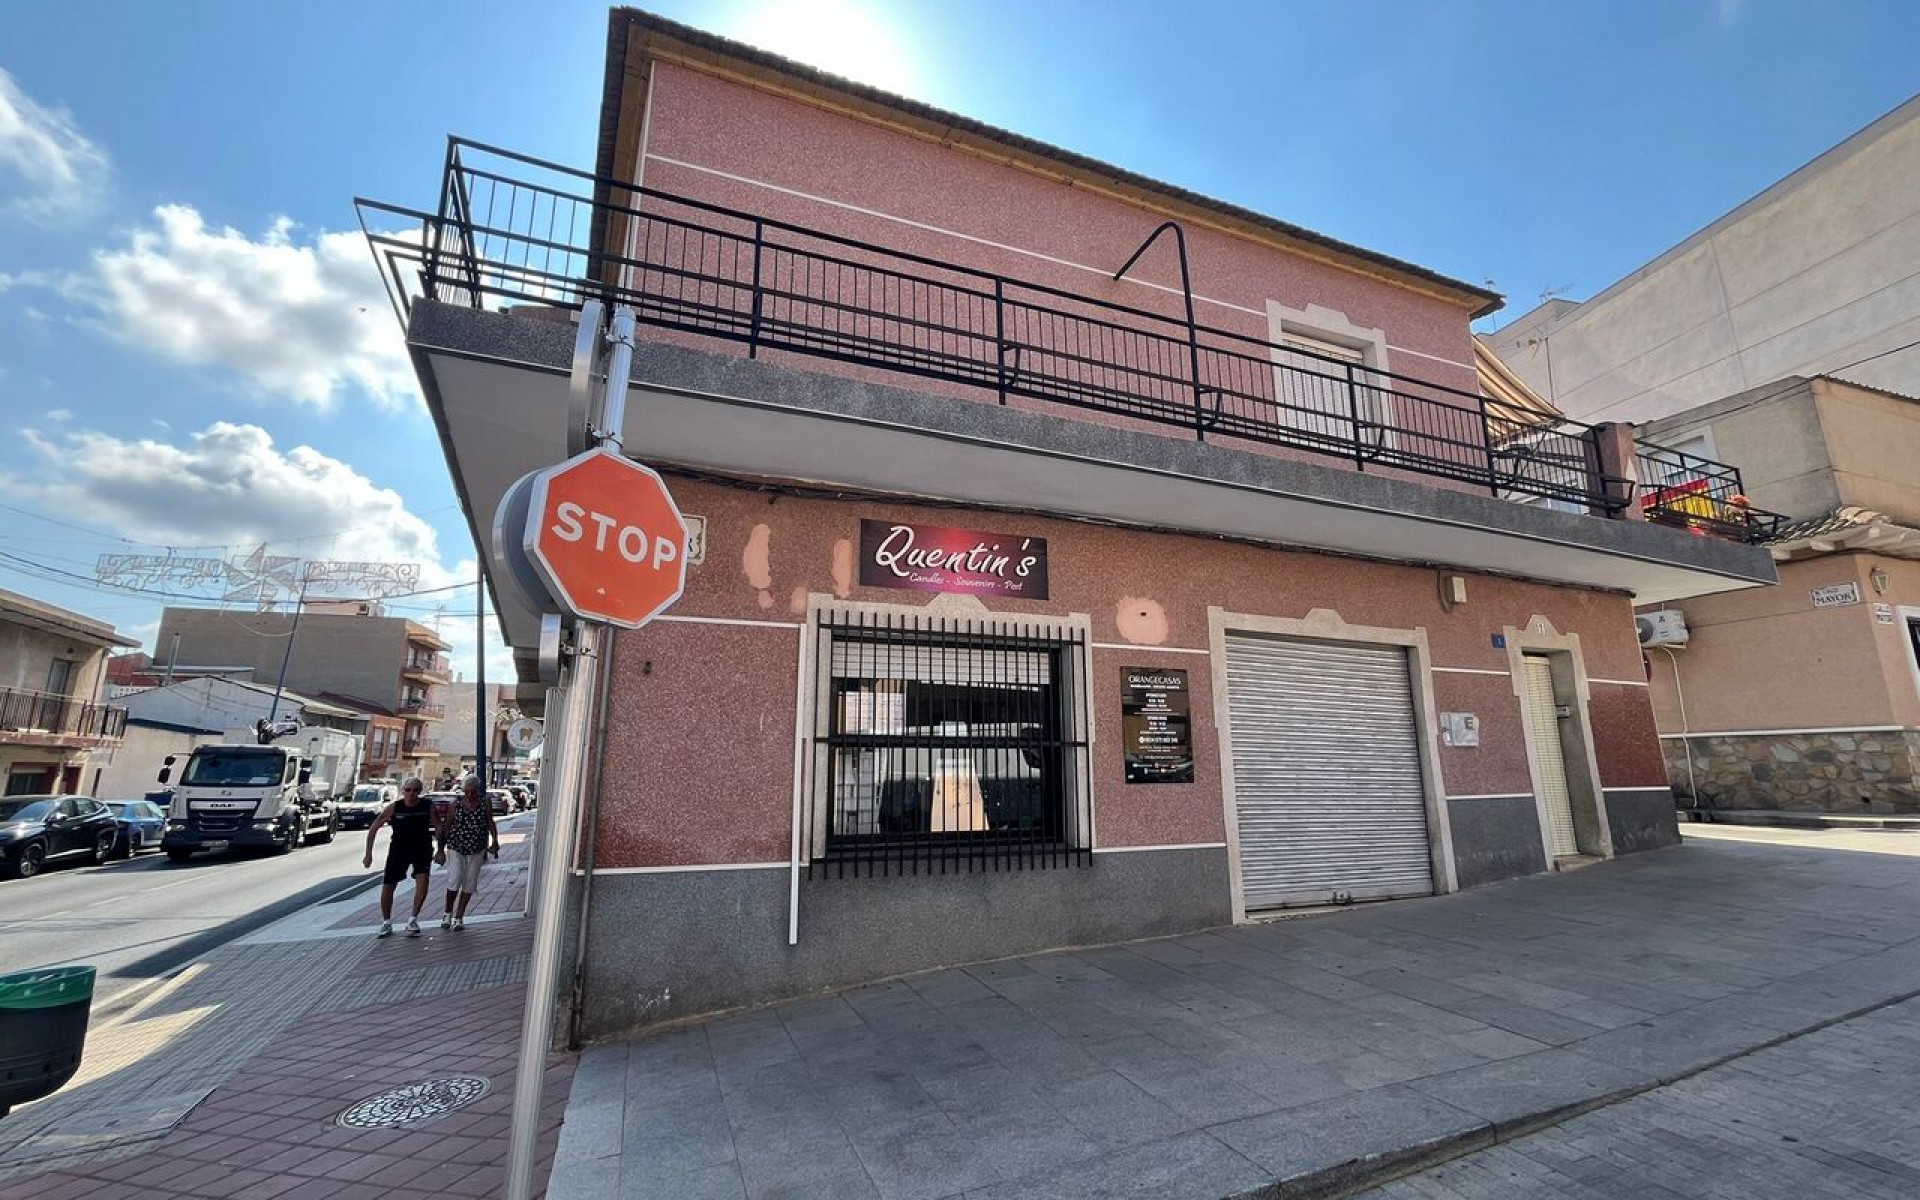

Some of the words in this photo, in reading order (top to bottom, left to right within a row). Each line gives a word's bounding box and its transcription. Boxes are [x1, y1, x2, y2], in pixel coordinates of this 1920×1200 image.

[552, 502, 676, 571] STOP
[875, 525, 1037, 577] Quentin's
[1816, 592, 1851, 603] MAYOR
